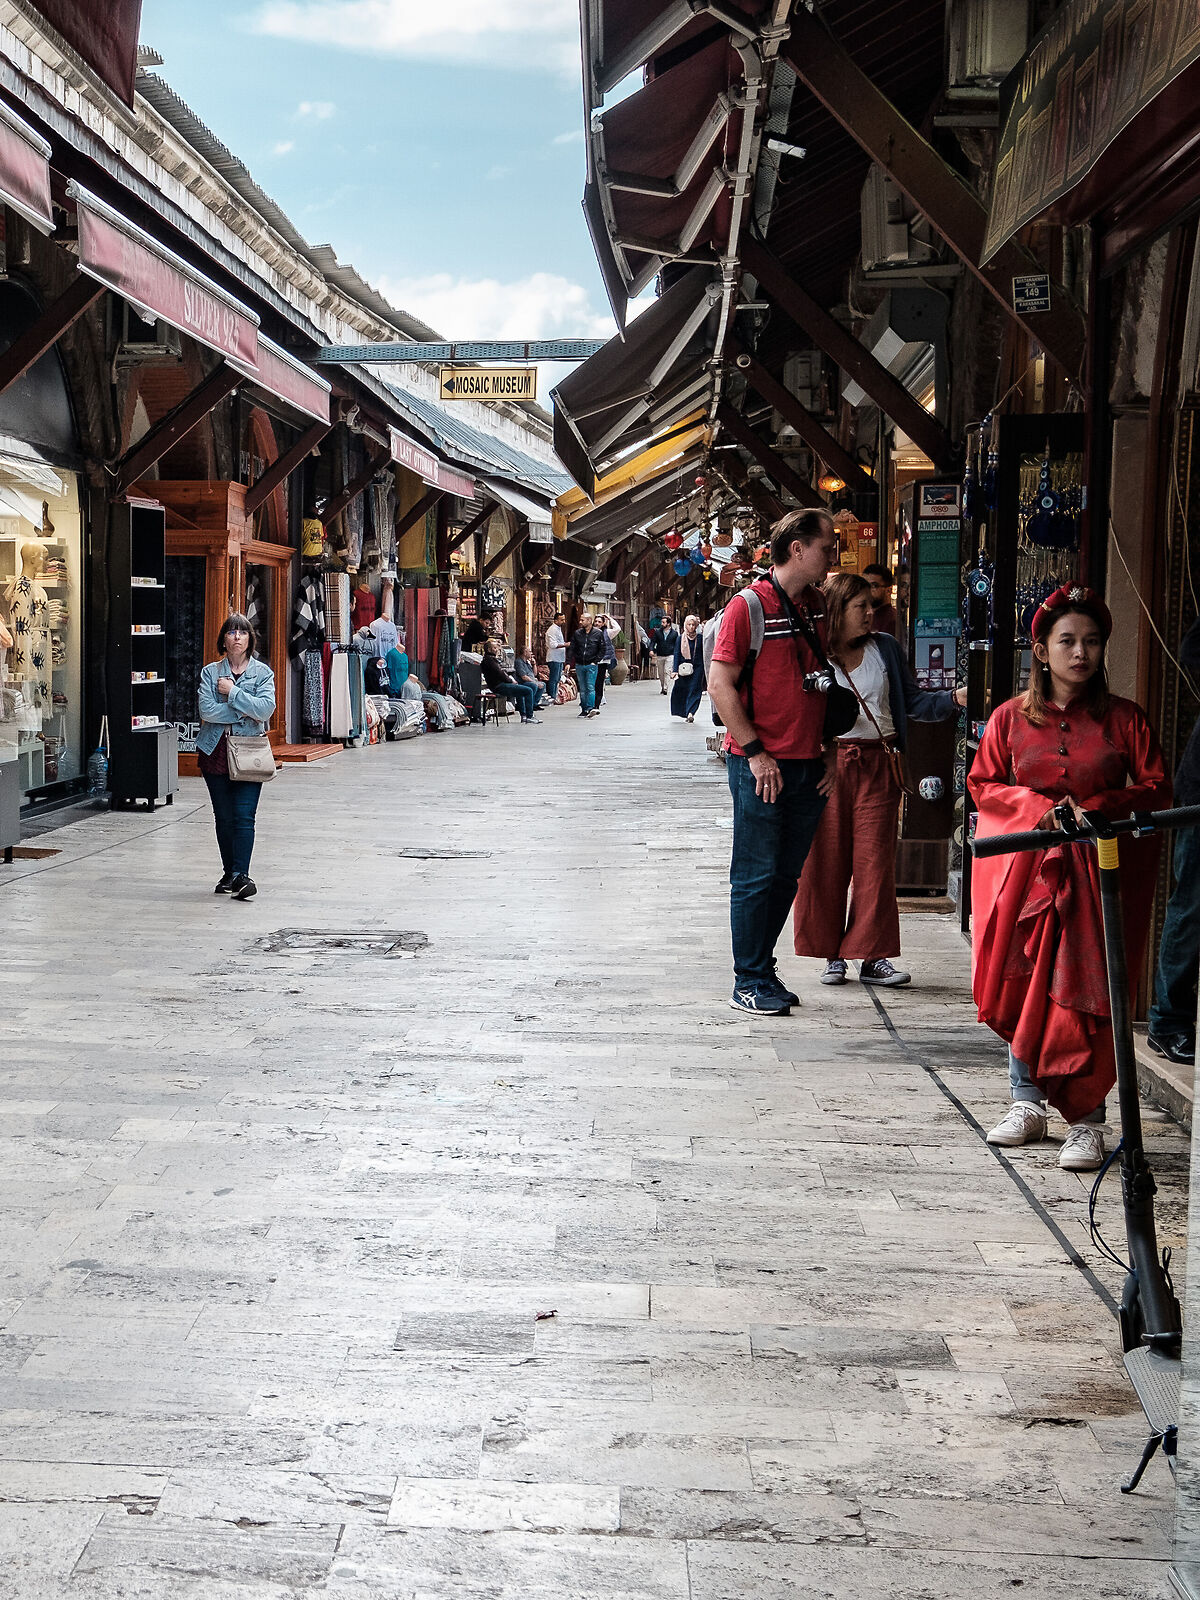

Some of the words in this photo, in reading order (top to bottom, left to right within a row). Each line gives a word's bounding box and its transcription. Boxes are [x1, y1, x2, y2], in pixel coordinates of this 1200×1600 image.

[1024, 287, 1040, 297] 149
[455, 376, 490, 393] MOSAIC
[492, 376, 531, 394] MUSEUM
[400, 441, 413, 464] LAST
[920, 520, 959, 530] AMPHORA
[863, 528, 874, 537] 66
